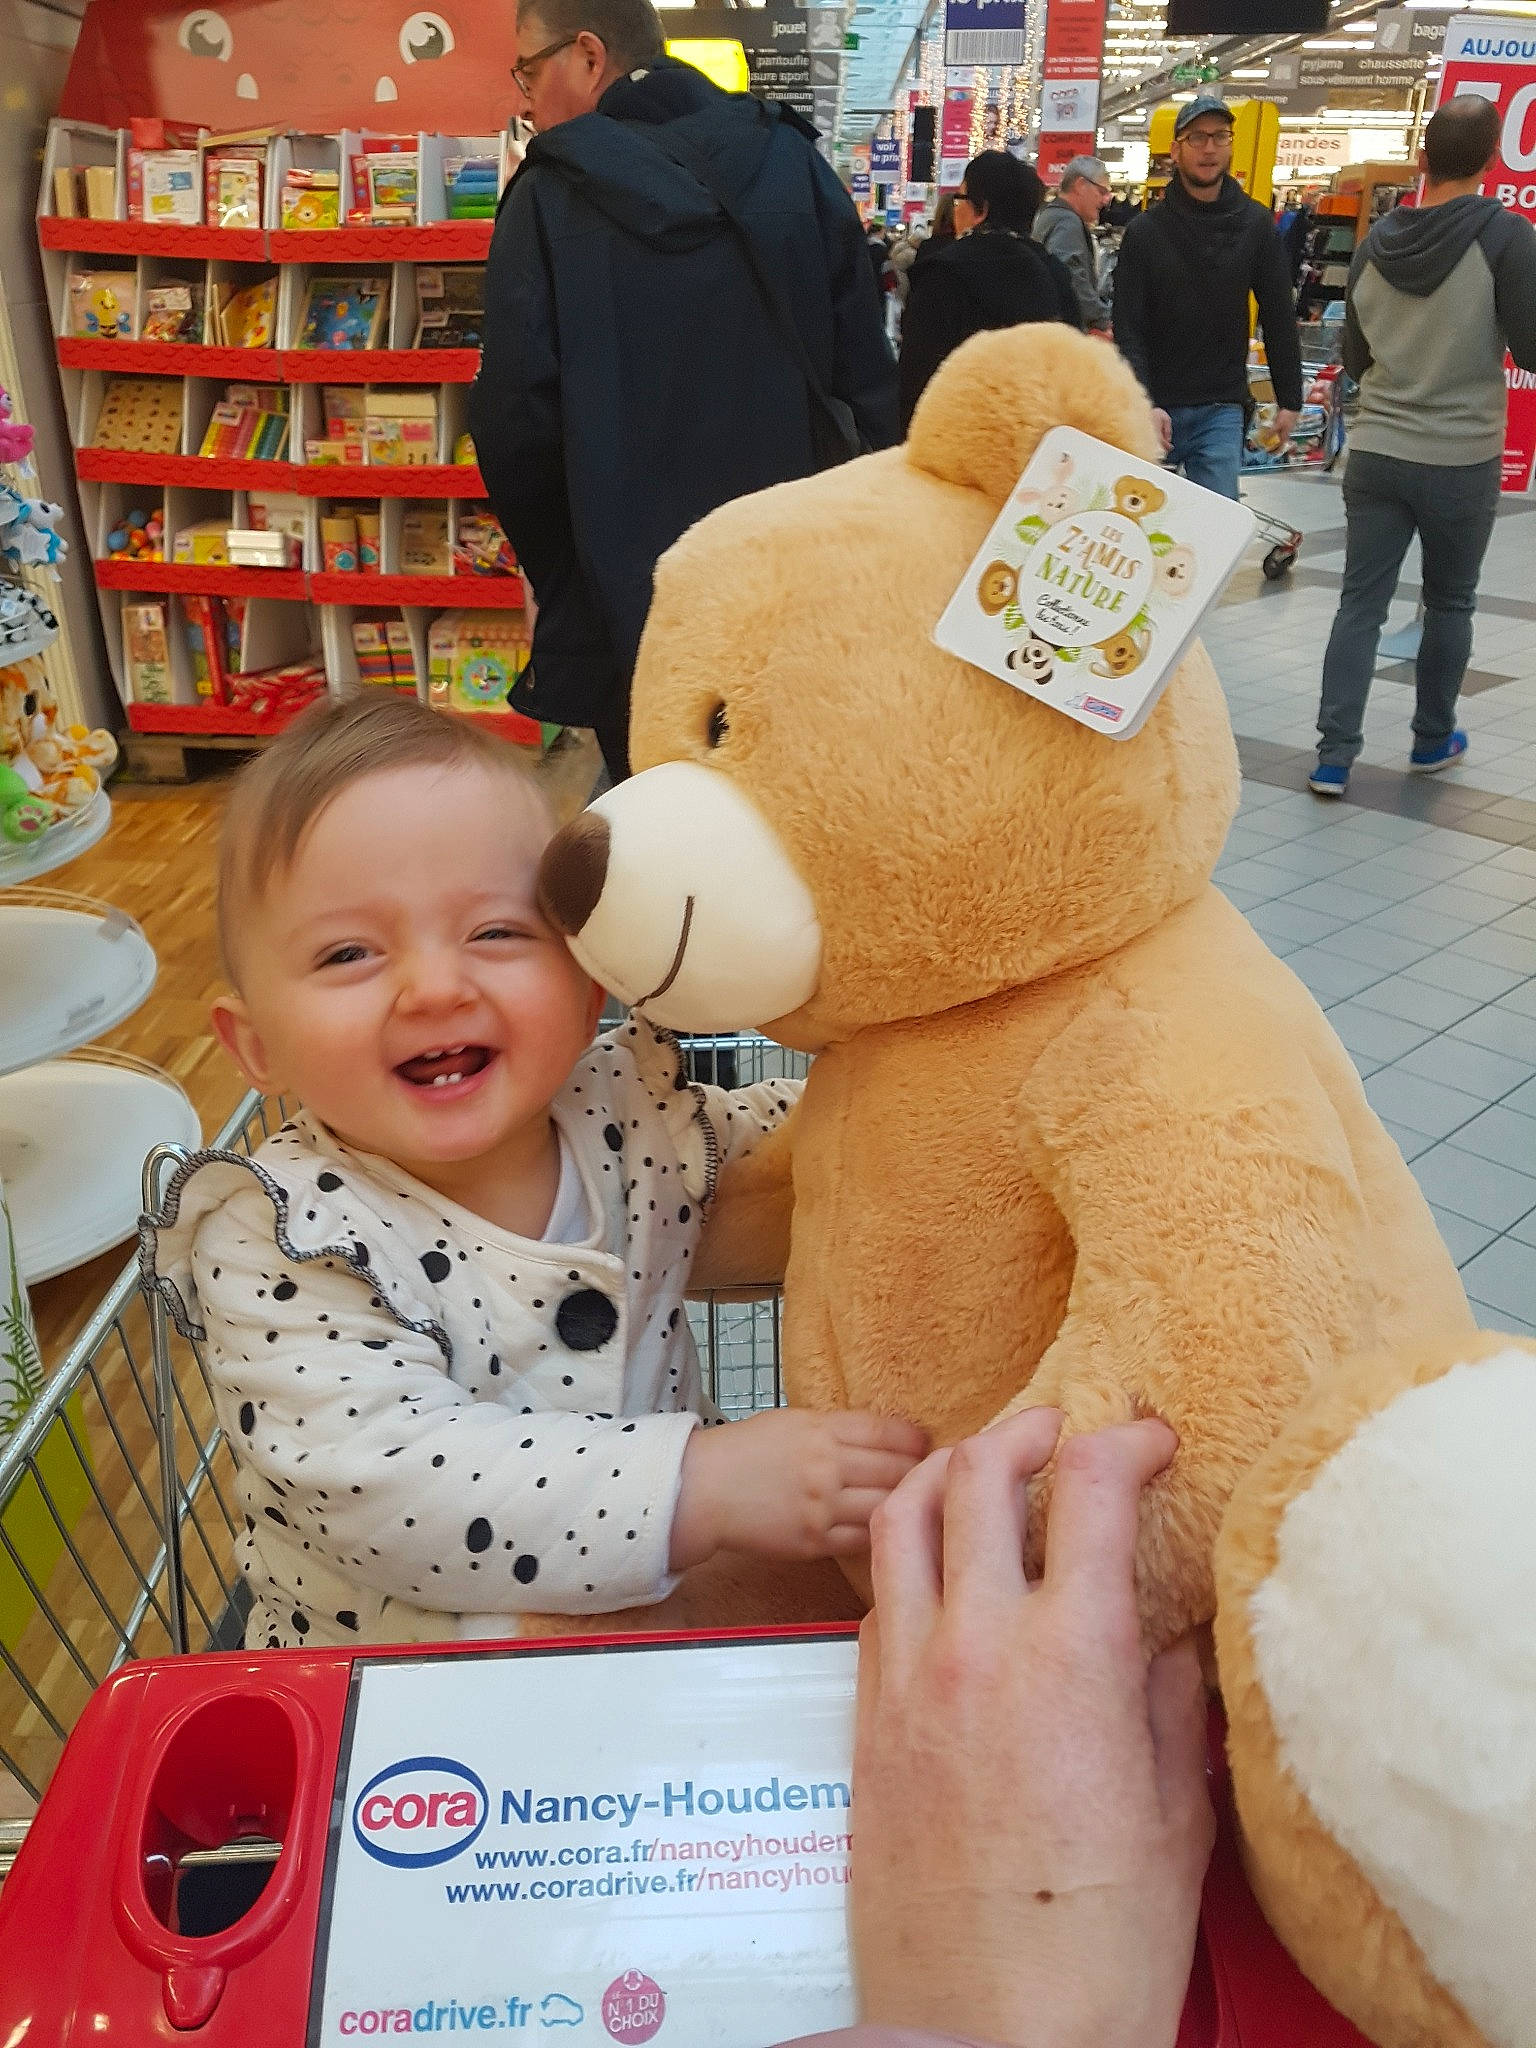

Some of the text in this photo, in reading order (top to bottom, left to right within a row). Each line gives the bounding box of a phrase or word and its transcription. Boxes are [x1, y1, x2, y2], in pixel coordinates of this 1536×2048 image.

[771, 20, 807, 38] jouet
[1461, 38, 1536, 57] AUJOU
[1301, 57, 1426, 71] pyjama chaussette
[1375, 75, 1415, 86] homme
[876, 142, 897, 151] voir
[1279, 137, 1340, 150] andes
[1276, 153, 1326, 166] ailles
[1035, 553, 1129, 614] NATURE
[362, 1777, 852, 1832] cora Nancy-Houdem
[475, 1830, 853, 1870] www.cora.fr/nancyhoudem
[445, 1862, 852, 1904] www.coradrive.fr/nancyhou
[639, 1993, 660, 2010] DU
[339, 1996, 534, 2035] coradrive.fr
[609, 2010, 659, 2033] CHOIX
